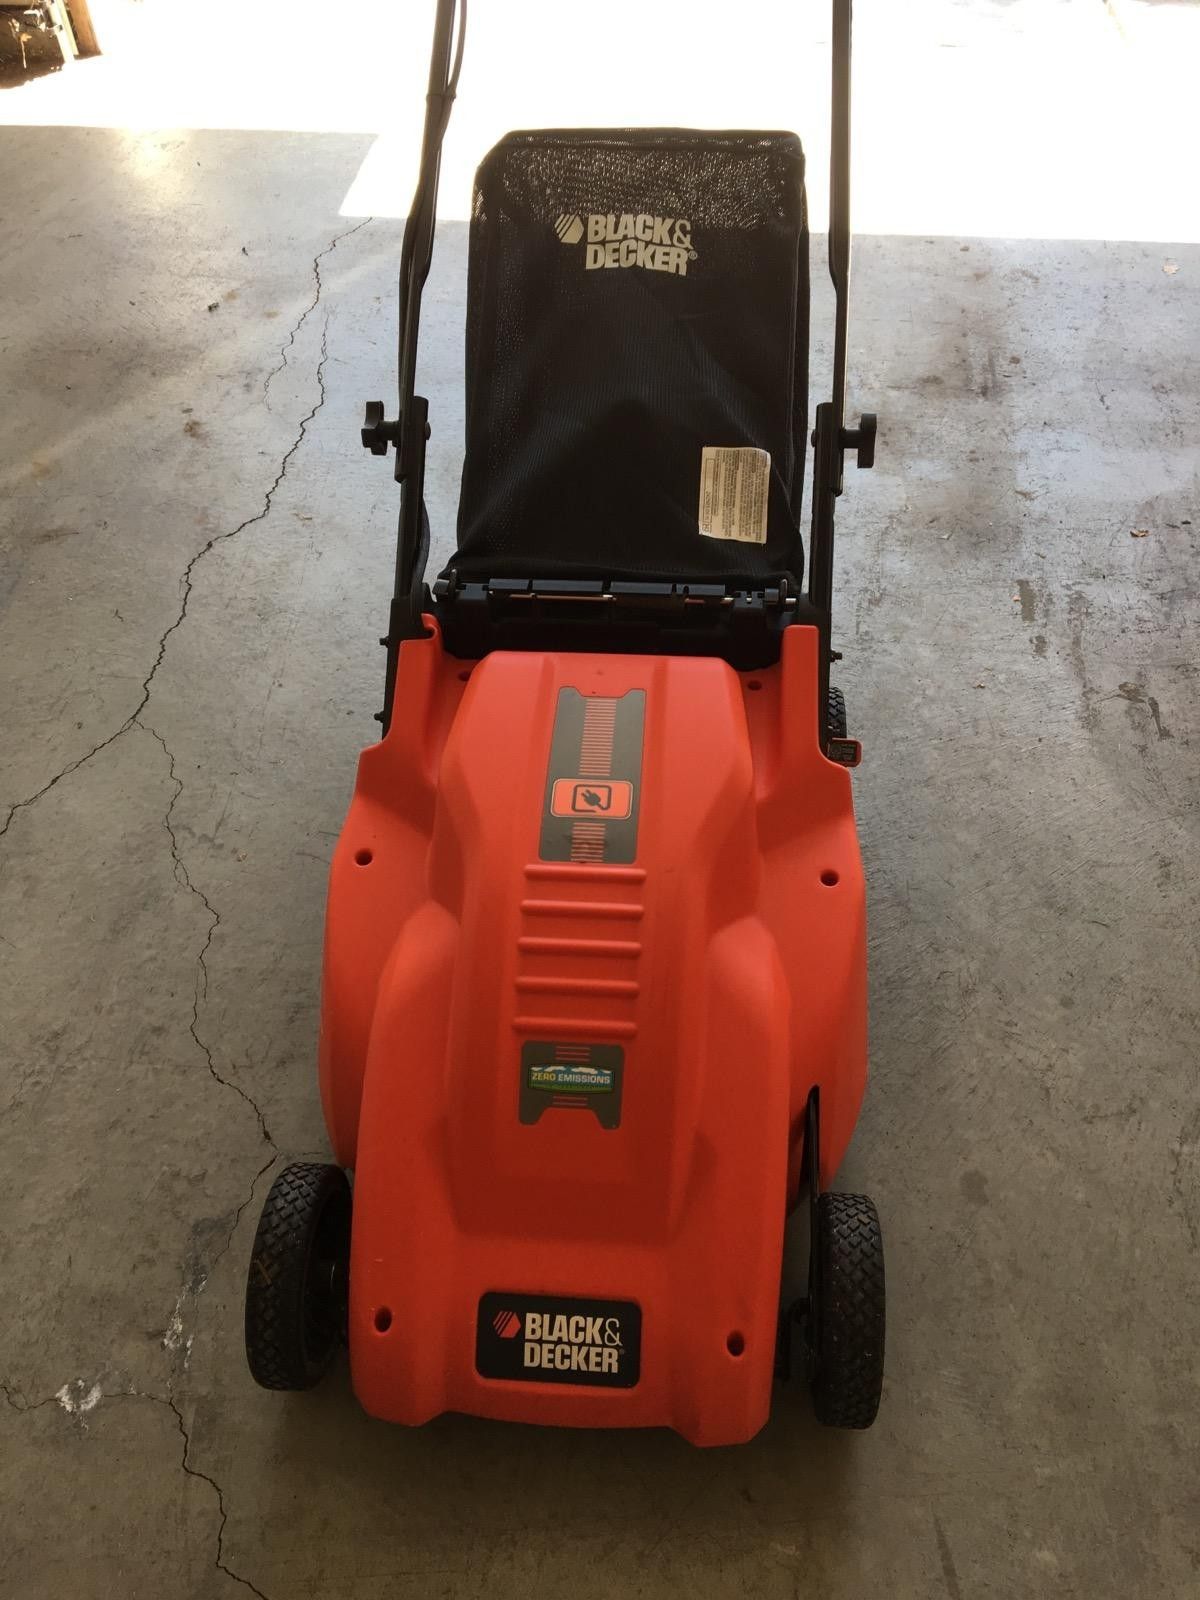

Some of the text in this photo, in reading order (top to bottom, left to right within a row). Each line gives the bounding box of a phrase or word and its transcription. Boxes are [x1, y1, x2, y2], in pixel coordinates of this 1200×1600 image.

[531, 1072, 611, 1084] ZERO EMISSIONS
[523, 1341, 619, 1374] DECKER
